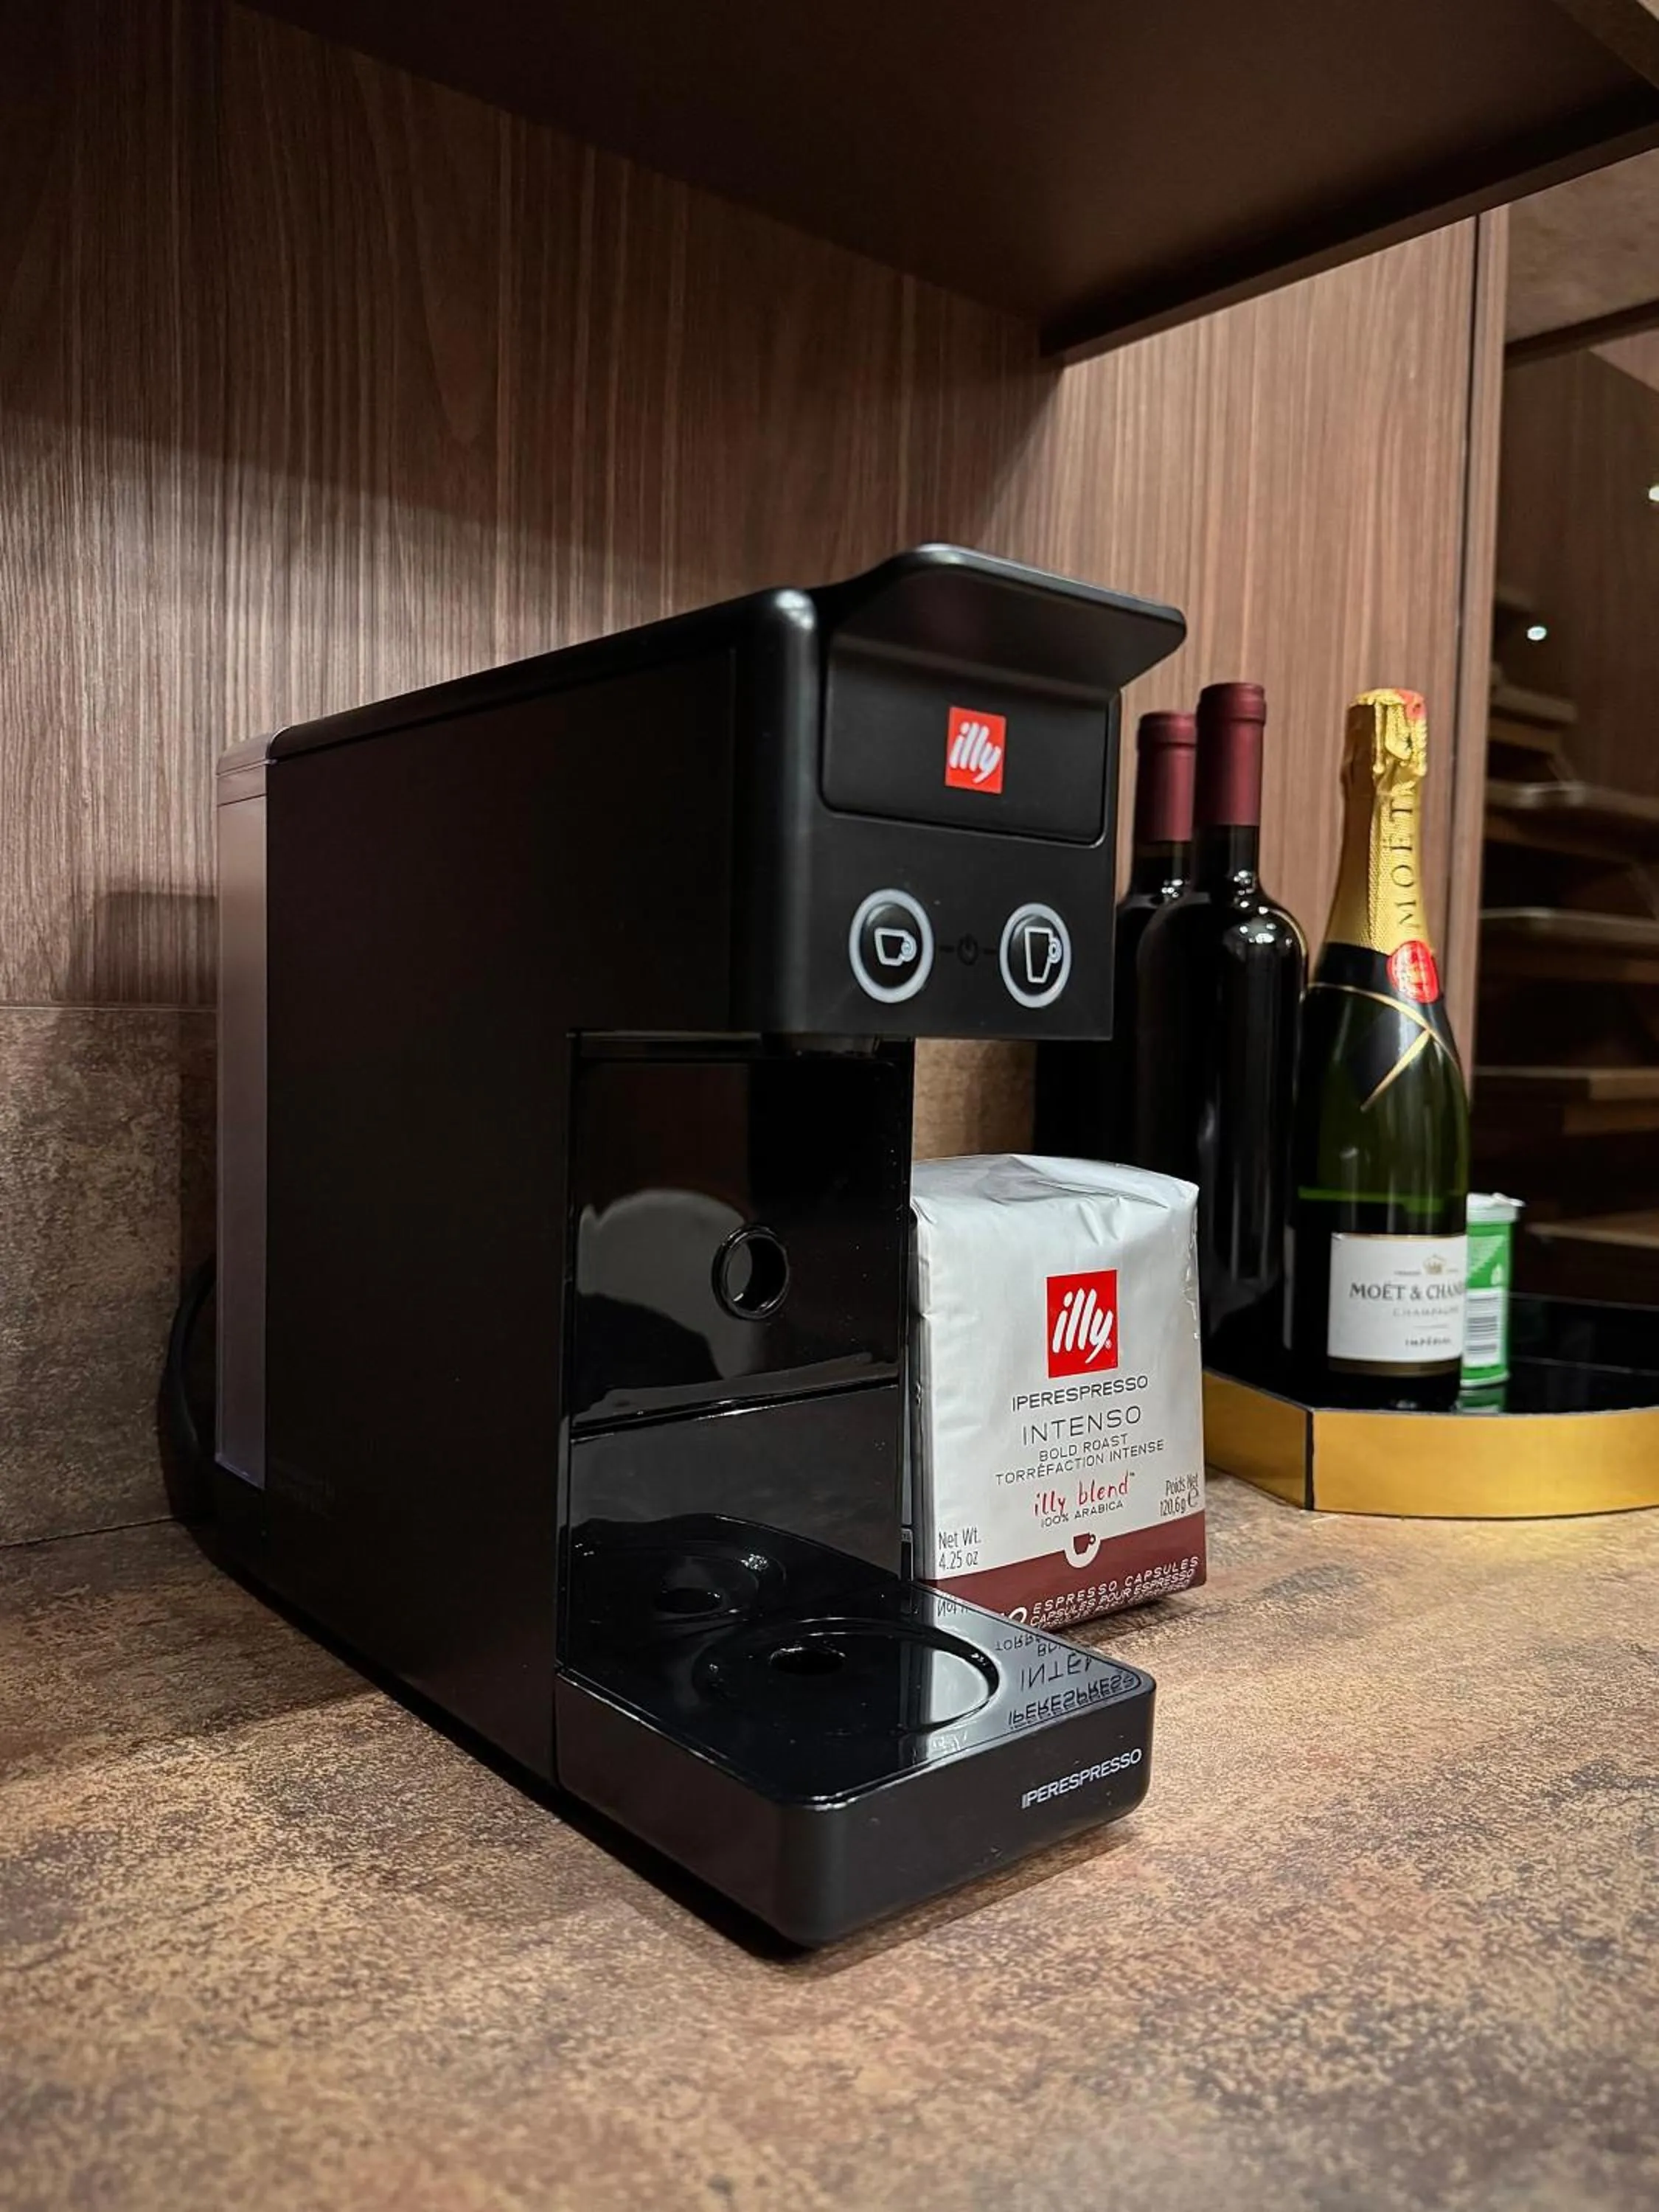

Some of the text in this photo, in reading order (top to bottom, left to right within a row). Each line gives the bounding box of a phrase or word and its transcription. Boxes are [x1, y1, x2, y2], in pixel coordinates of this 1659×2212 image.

[950, 722, 1001, 784] illy
[1409, 1284, 1422, 1301] &
[1052, 1288, 1113, 1364] illy
[1012, 1375, 1148, 1412] IPERESPRESSO
[1023, 1405, 1141, 1445] INTENSO
[995, 1439, 1164, 1486] TORRÉFACTION INTENSE
[1040, 1433, 1129, 1462] BOLD ROAST
[1034, 1489, 1066, 1517] illy
[1041, 1500, 1124, 1528] 100% ARABICA
[939, 1531, 959, 1550] Net
[939, 1551, 978, 1570] 4.25 oz
[1033, 1580, 1118, 1615] ESPRESSO
[1125, 1556, 1199, 1586] CAPSULES
[1133, 1568, 1195, 1595] ESPRESSO
[1021, 1747, 1142, 1809] IPERESPRESSO
